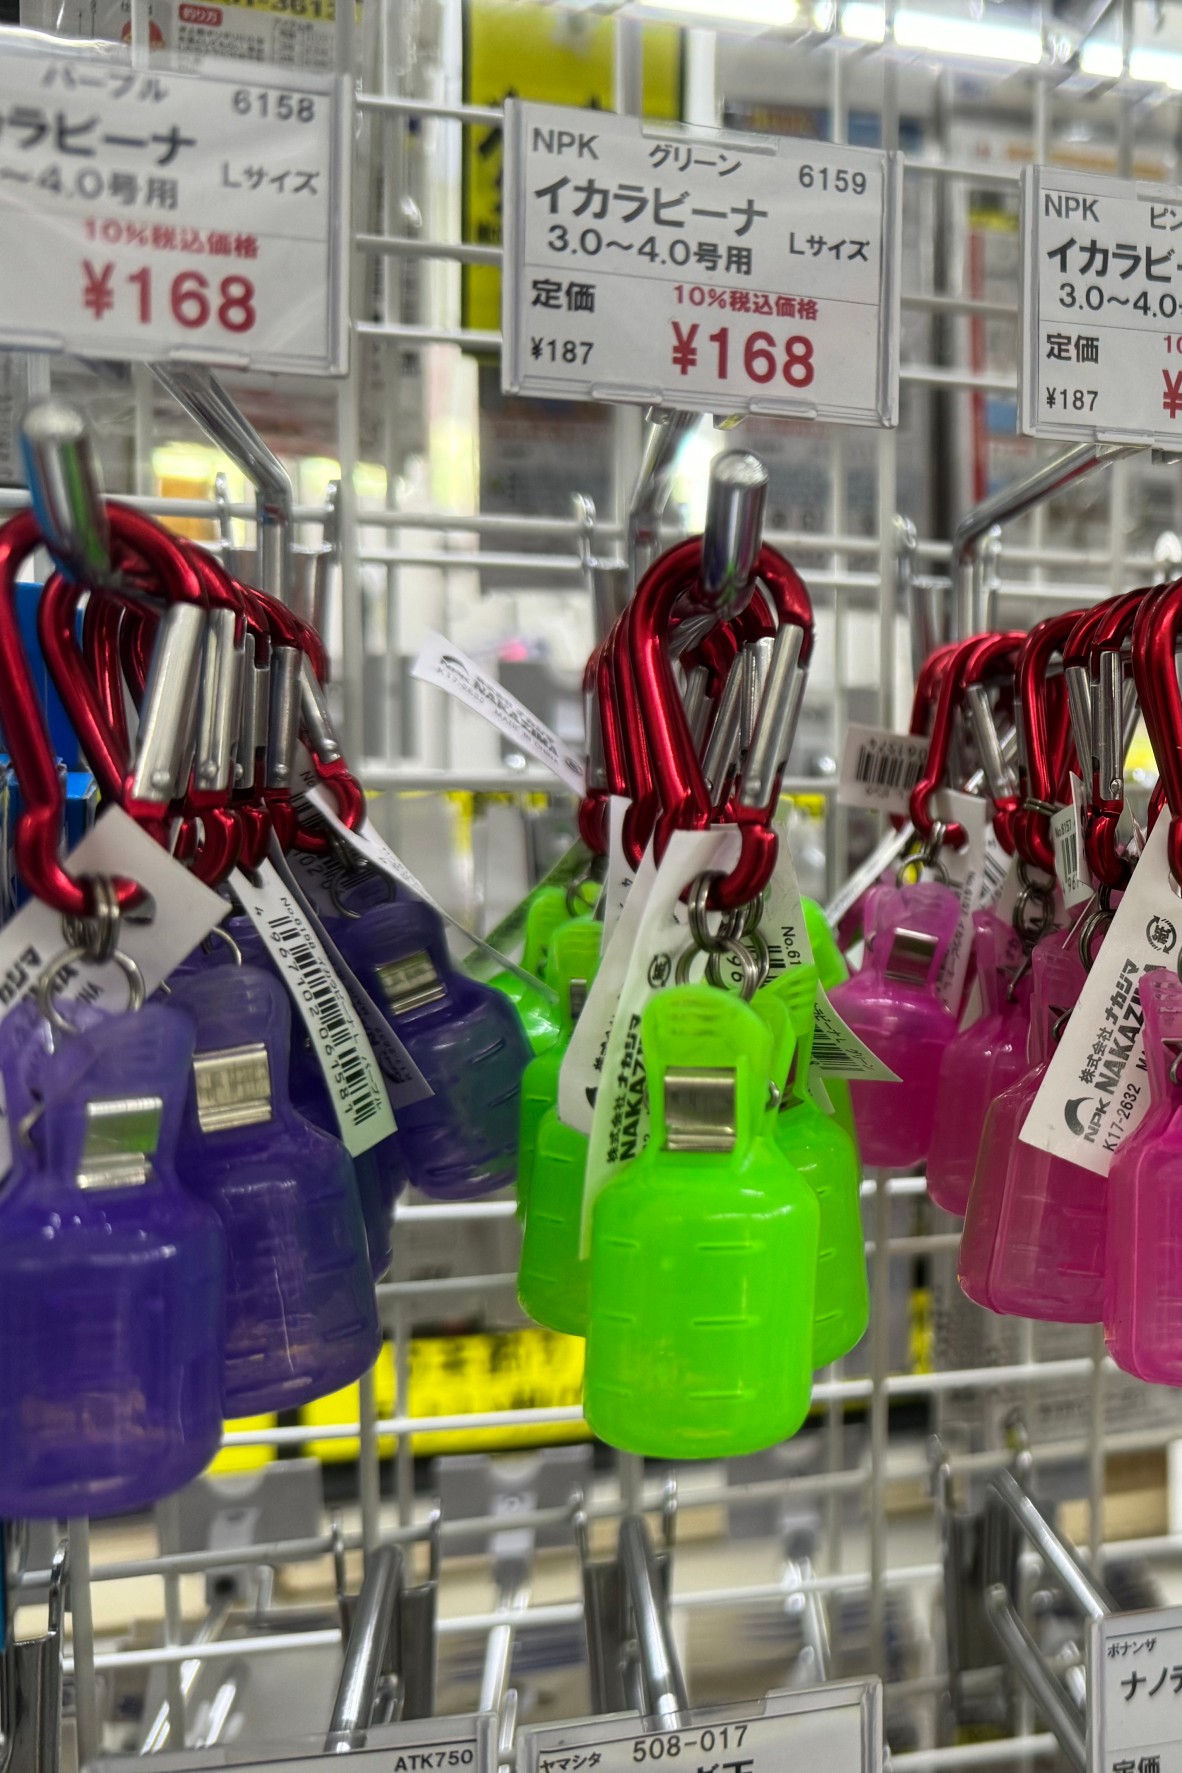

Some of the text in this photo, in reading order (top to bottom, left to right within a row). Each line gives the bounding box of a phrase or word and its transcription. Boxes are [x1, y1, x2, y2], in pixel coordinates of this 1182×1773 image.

[232, 89, 316, 123] 6158
[0, 106, 197, 167] ラビーナ
[222, 161, 320, 197] Lサイズ
[532, 127, 868, 196] NPK グリーン 6159
[534, 176, 769, 237] イカラビーナ
[1044, 193, 1100, 223] NPK
[84, 216, 260, 260] 10%税込価格
[789, 232, 870, 262] Lサイズ
[81, 258, 258, 335] ¥168
[531, 278, 820, 321] 定価 10%税込価格
[530, 320, 815, 389] ¥187 ¥168
[1046, 333, 1100, 365] 定価
[1046, 386, 1099, 412] ¥187
[780, 925, 802, 966] No.61
[270, 932, 321, 1018] 967102
[317, 1027, 356, 1115] 061581
[1078, 957, 1140, 1085] 株式会社 ナカジマ
[1084, 1096, 1112, 1144] NPK
[1102, 1082, 1142, 1152] K17-2632
[1107, 1636, 1158, 1659] ボナンザ
[394, 1748, 474, 1773] ATK750
[540, 1750, 603, 1773] ヤマシタ
[632, 1723, 749, 1763] 508-017
